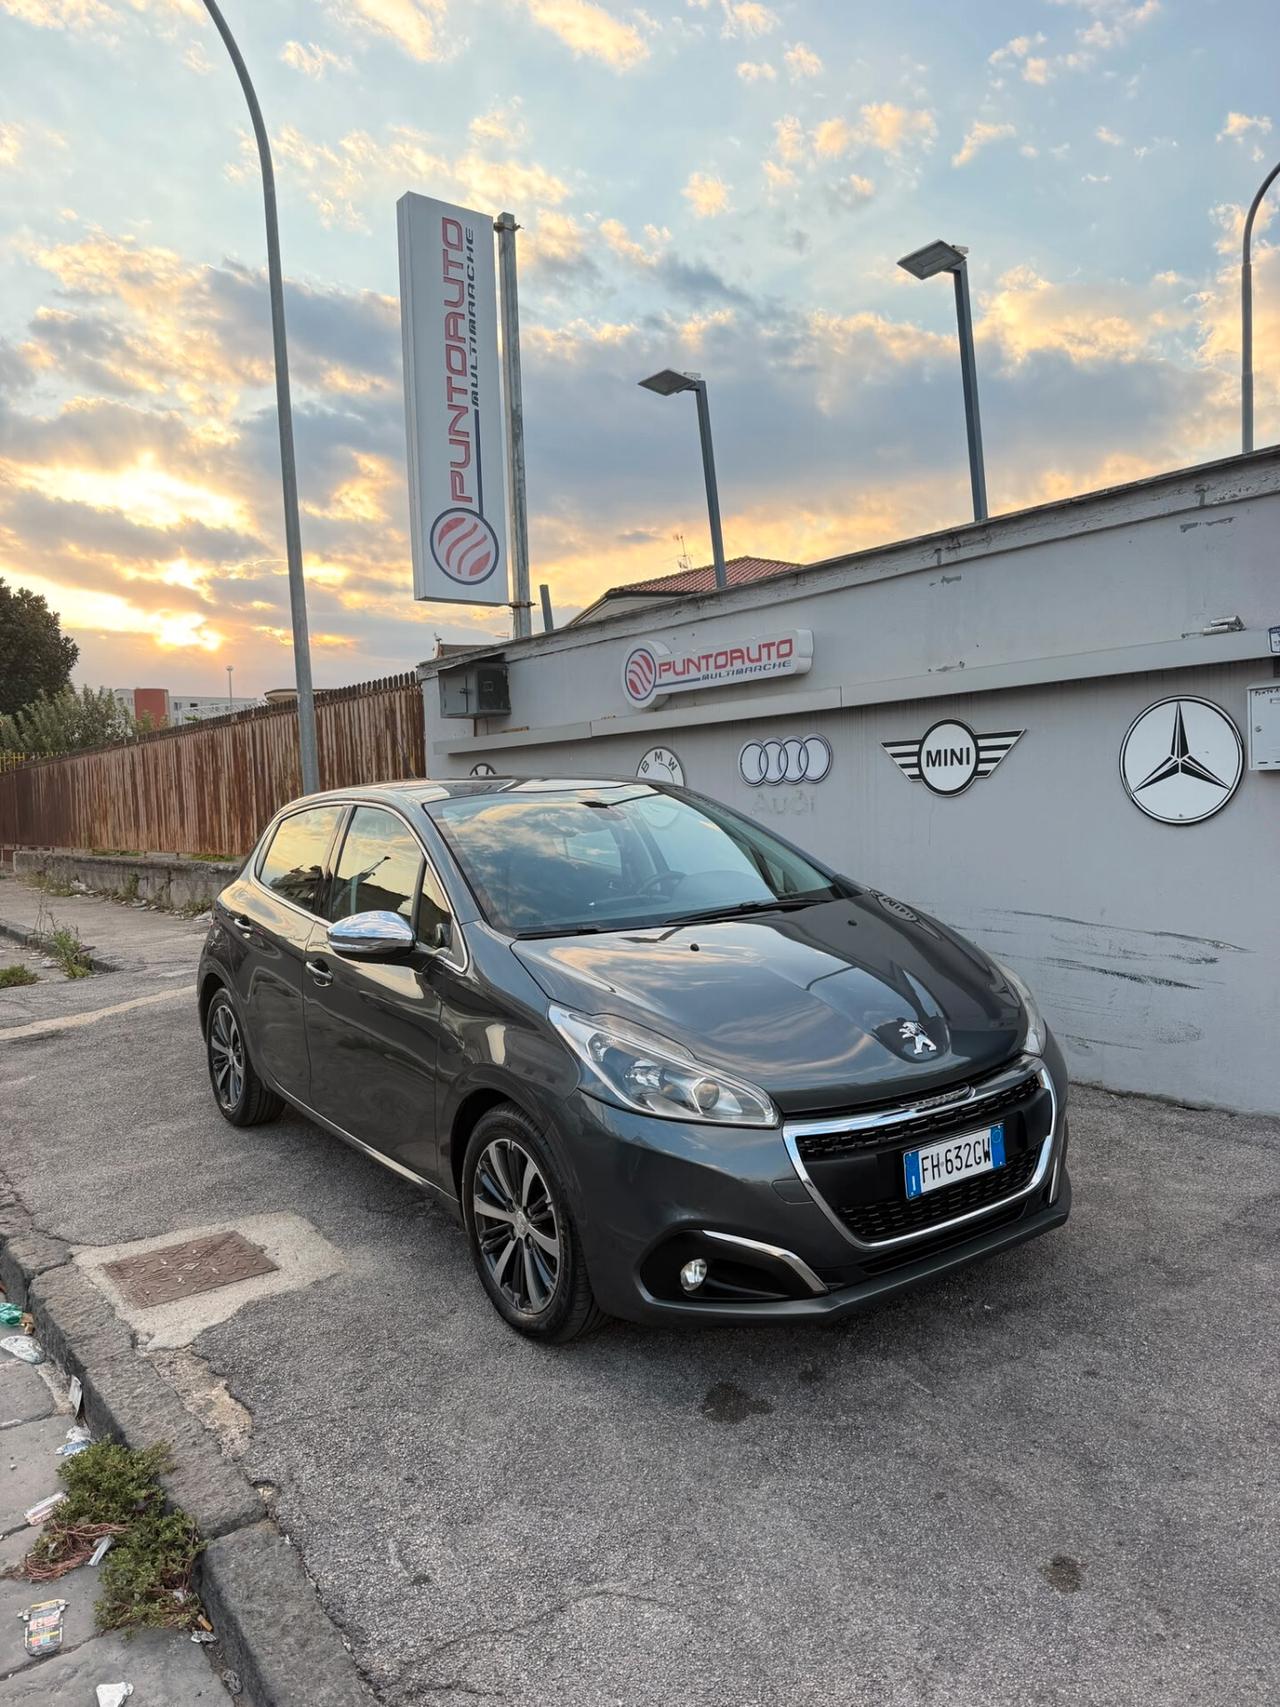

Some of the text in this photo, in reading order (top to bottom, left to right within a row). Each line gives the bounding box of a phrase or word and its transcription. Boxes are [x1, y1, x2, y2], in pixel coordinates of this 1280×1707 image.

[465, 227, 480, 408] MULTIMARCHE
[442, 217, 473, 503] PUNTOAUTO
[658, 638, 793, 680] PUNTOAUTO
[701, 659, 792, 681] MULTIMARCHE
[641, 751, 678, 774] BMW
[926, 747, 970, 768] MINI
